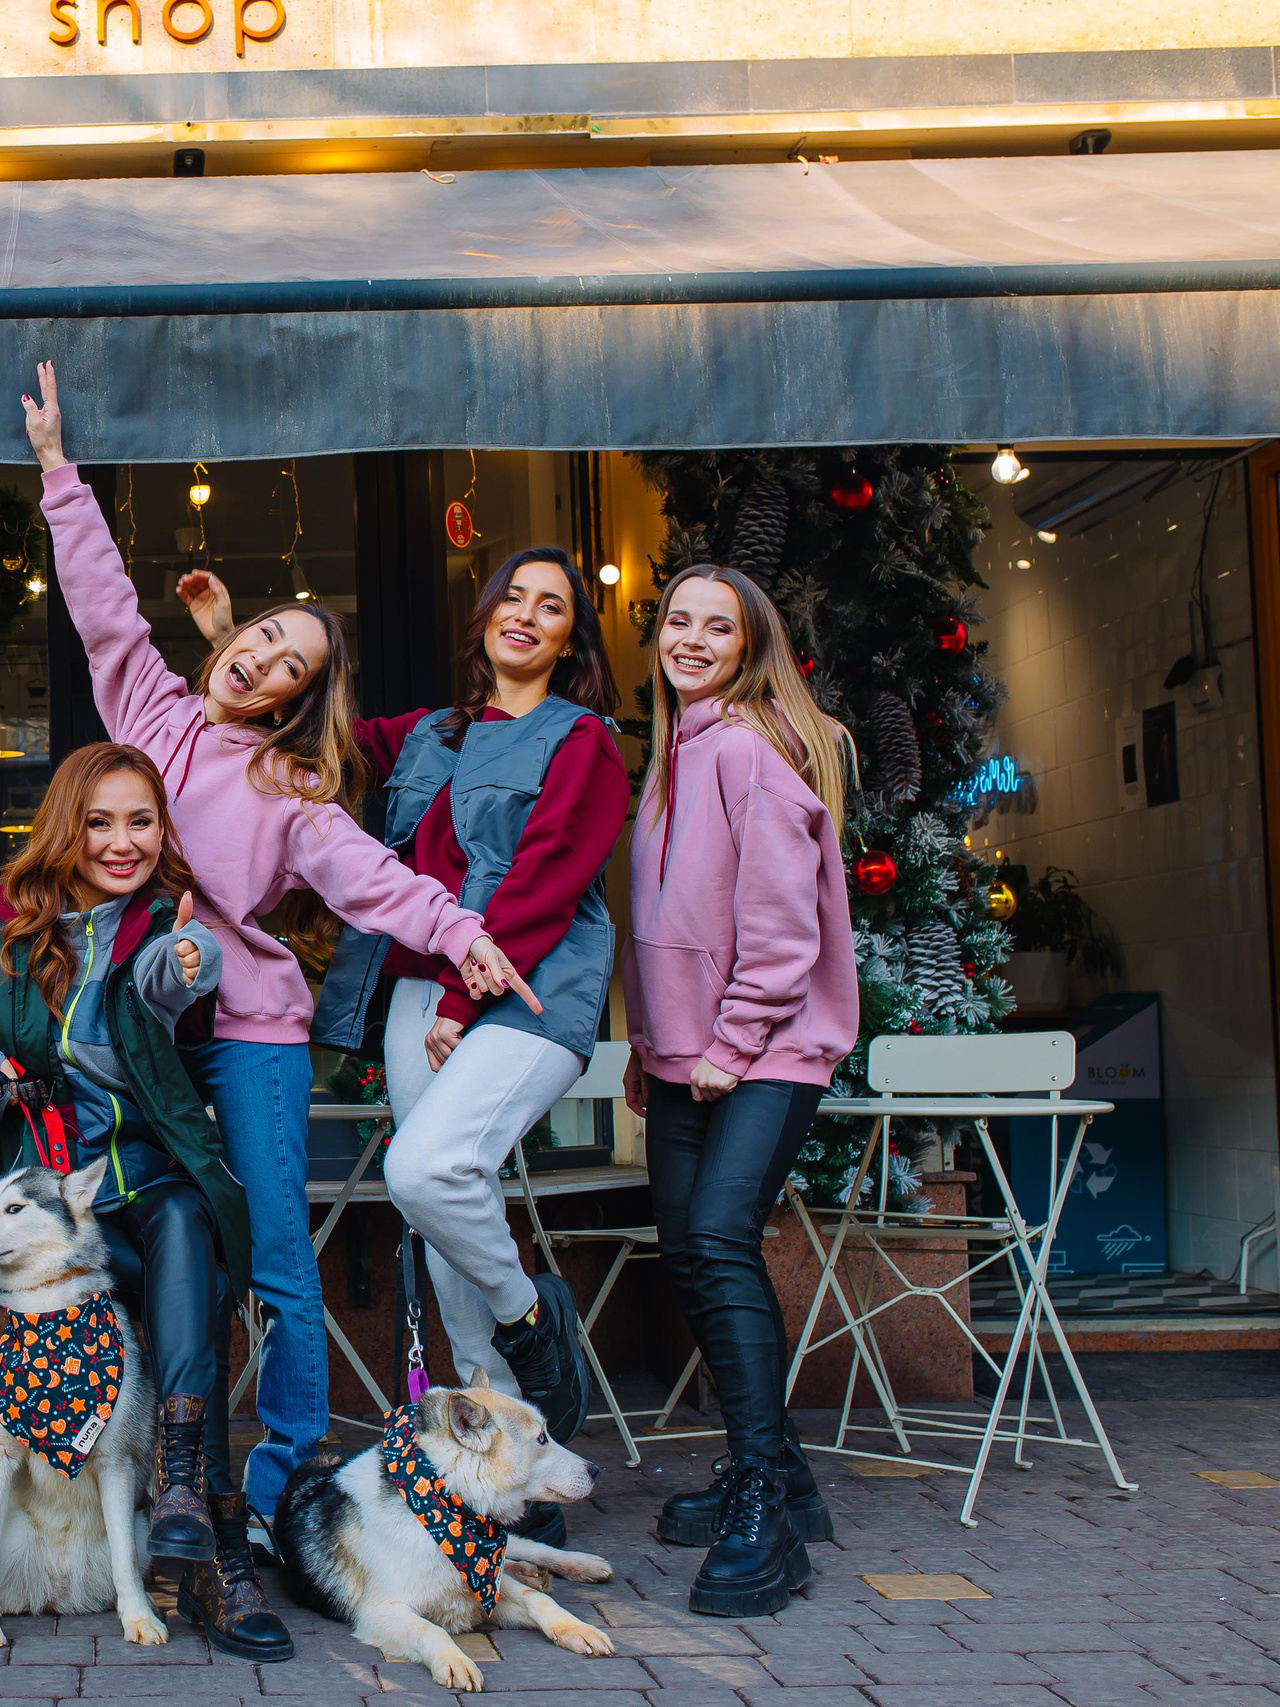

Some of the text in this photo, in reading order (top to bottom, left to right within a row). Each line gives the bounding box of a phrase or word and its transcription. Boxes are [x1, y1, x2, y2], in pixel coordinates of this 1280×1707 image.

[48, 0, 287, 58] shop
[1087, 1064, 1146, 1080] BLOOM
[78, 1421, 98, 1448] nuna
